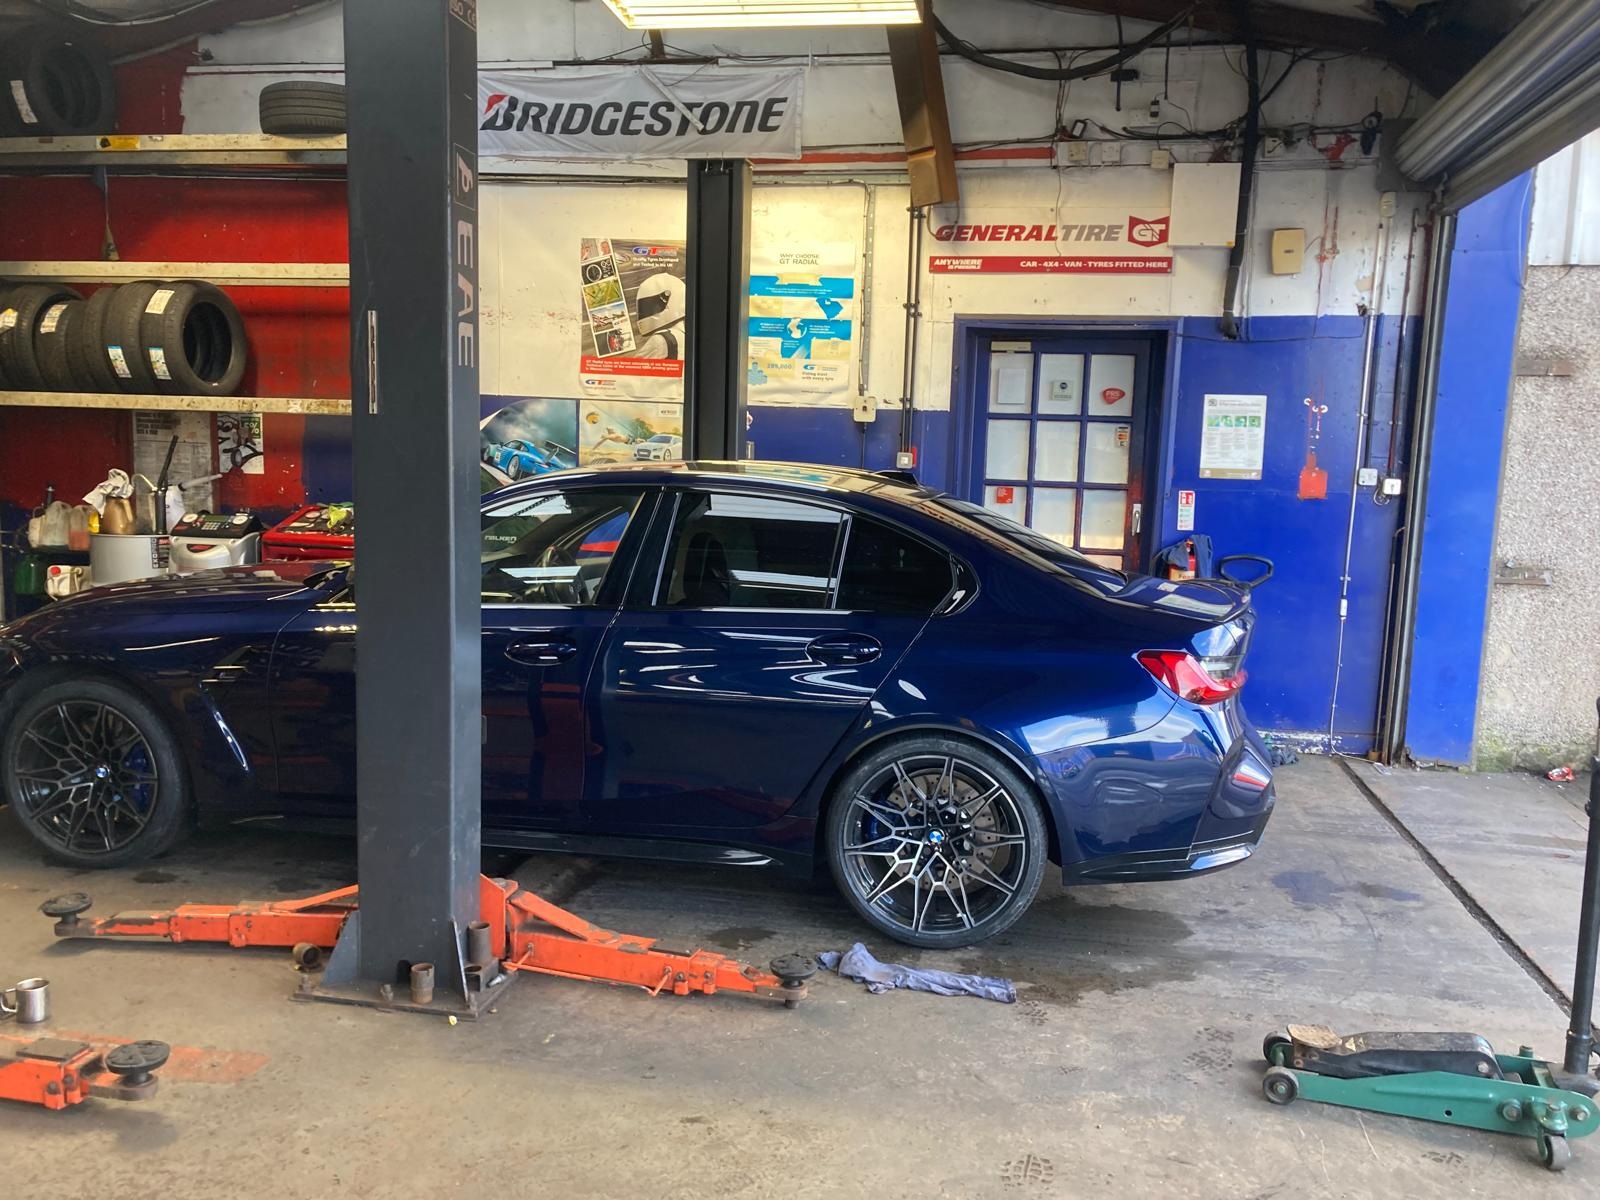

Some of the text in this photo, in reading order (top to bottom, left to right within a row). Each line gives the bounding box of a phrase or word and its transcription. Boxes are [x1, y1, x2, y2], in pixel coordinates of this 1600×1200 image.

[479, 93, 788, 137] BRIDGESTONE
[934, 258, 983, 266] ANYWHERE
[457, 219, 475, 369] EAE
